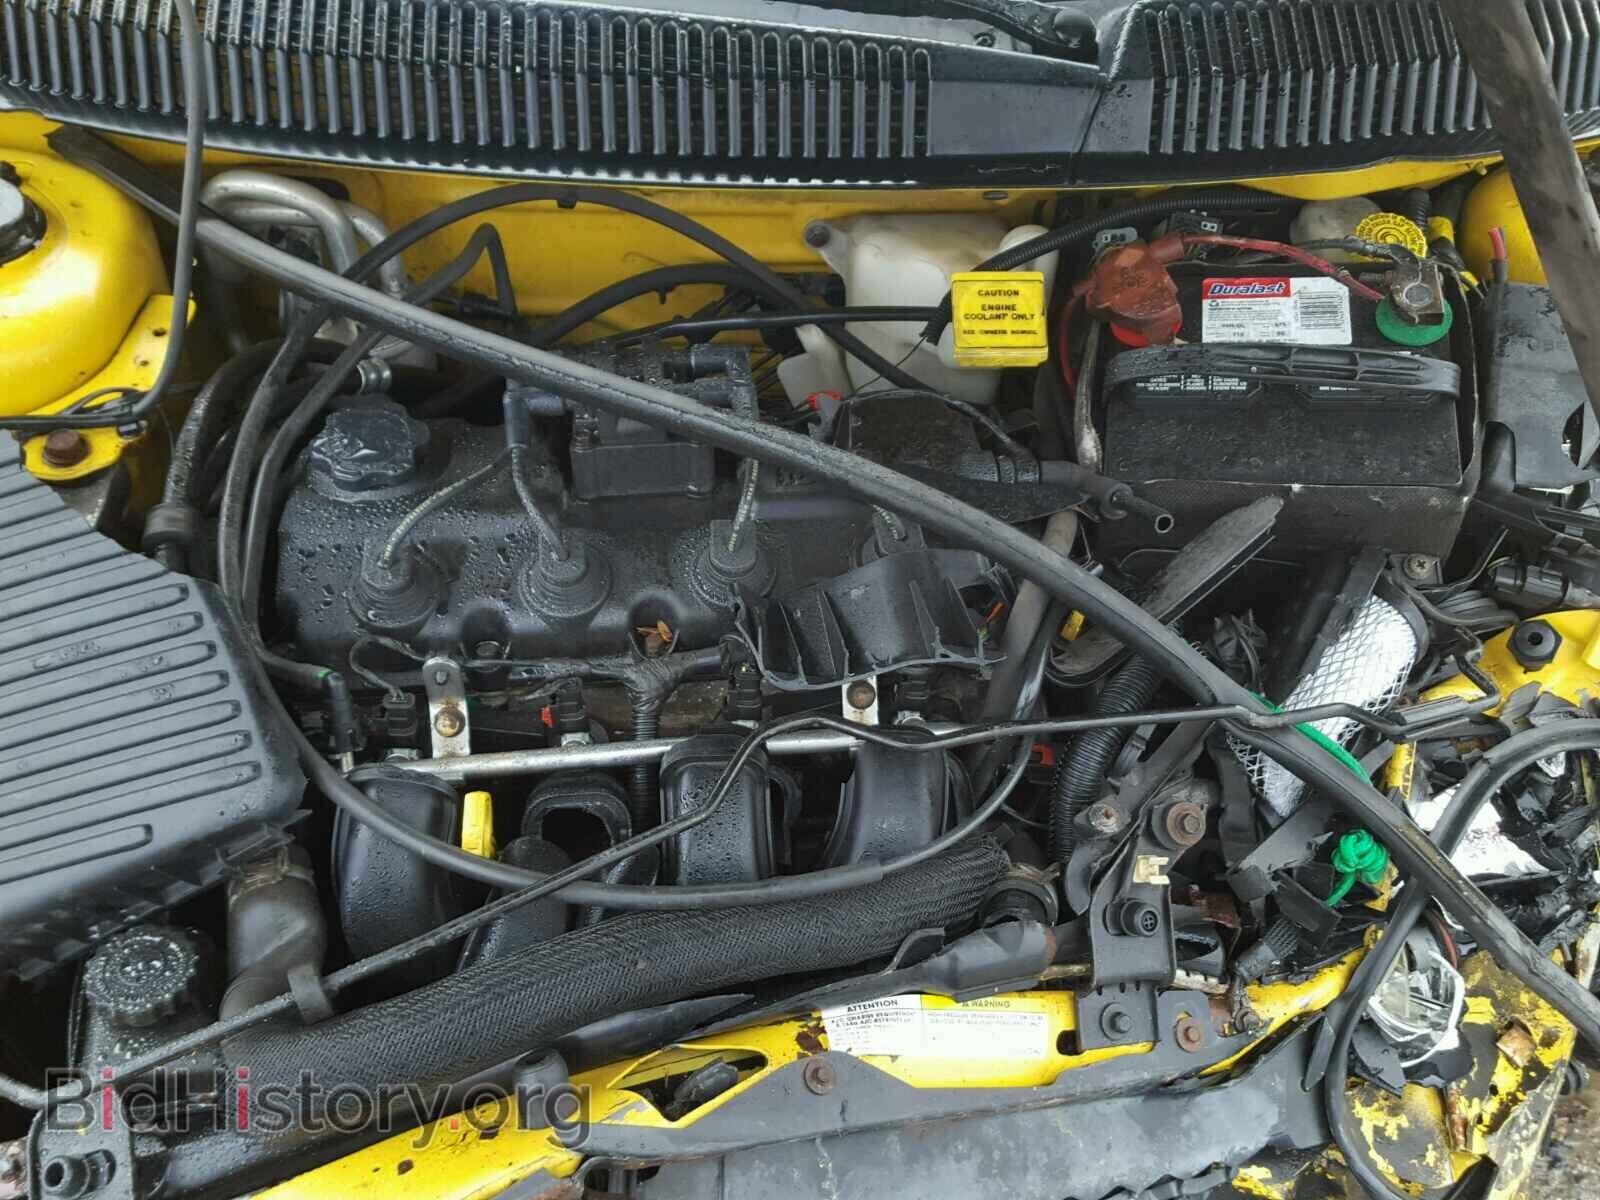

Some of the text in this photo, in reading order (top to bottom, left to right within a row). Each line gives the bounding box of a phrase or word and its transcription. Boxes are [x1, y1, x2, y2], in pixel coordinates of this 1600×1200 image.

[977, 288, 1020, 297] CAUTION
[1209, 282, 1286, 295] Duralast
[980, 303, 1017, 312] ENGINE
[963, 312, 1035, 321] COOLANT ONLY
[846, 999, 898, 1013] ATTENTION
[971, 999, 1011, 1009] WARNING
